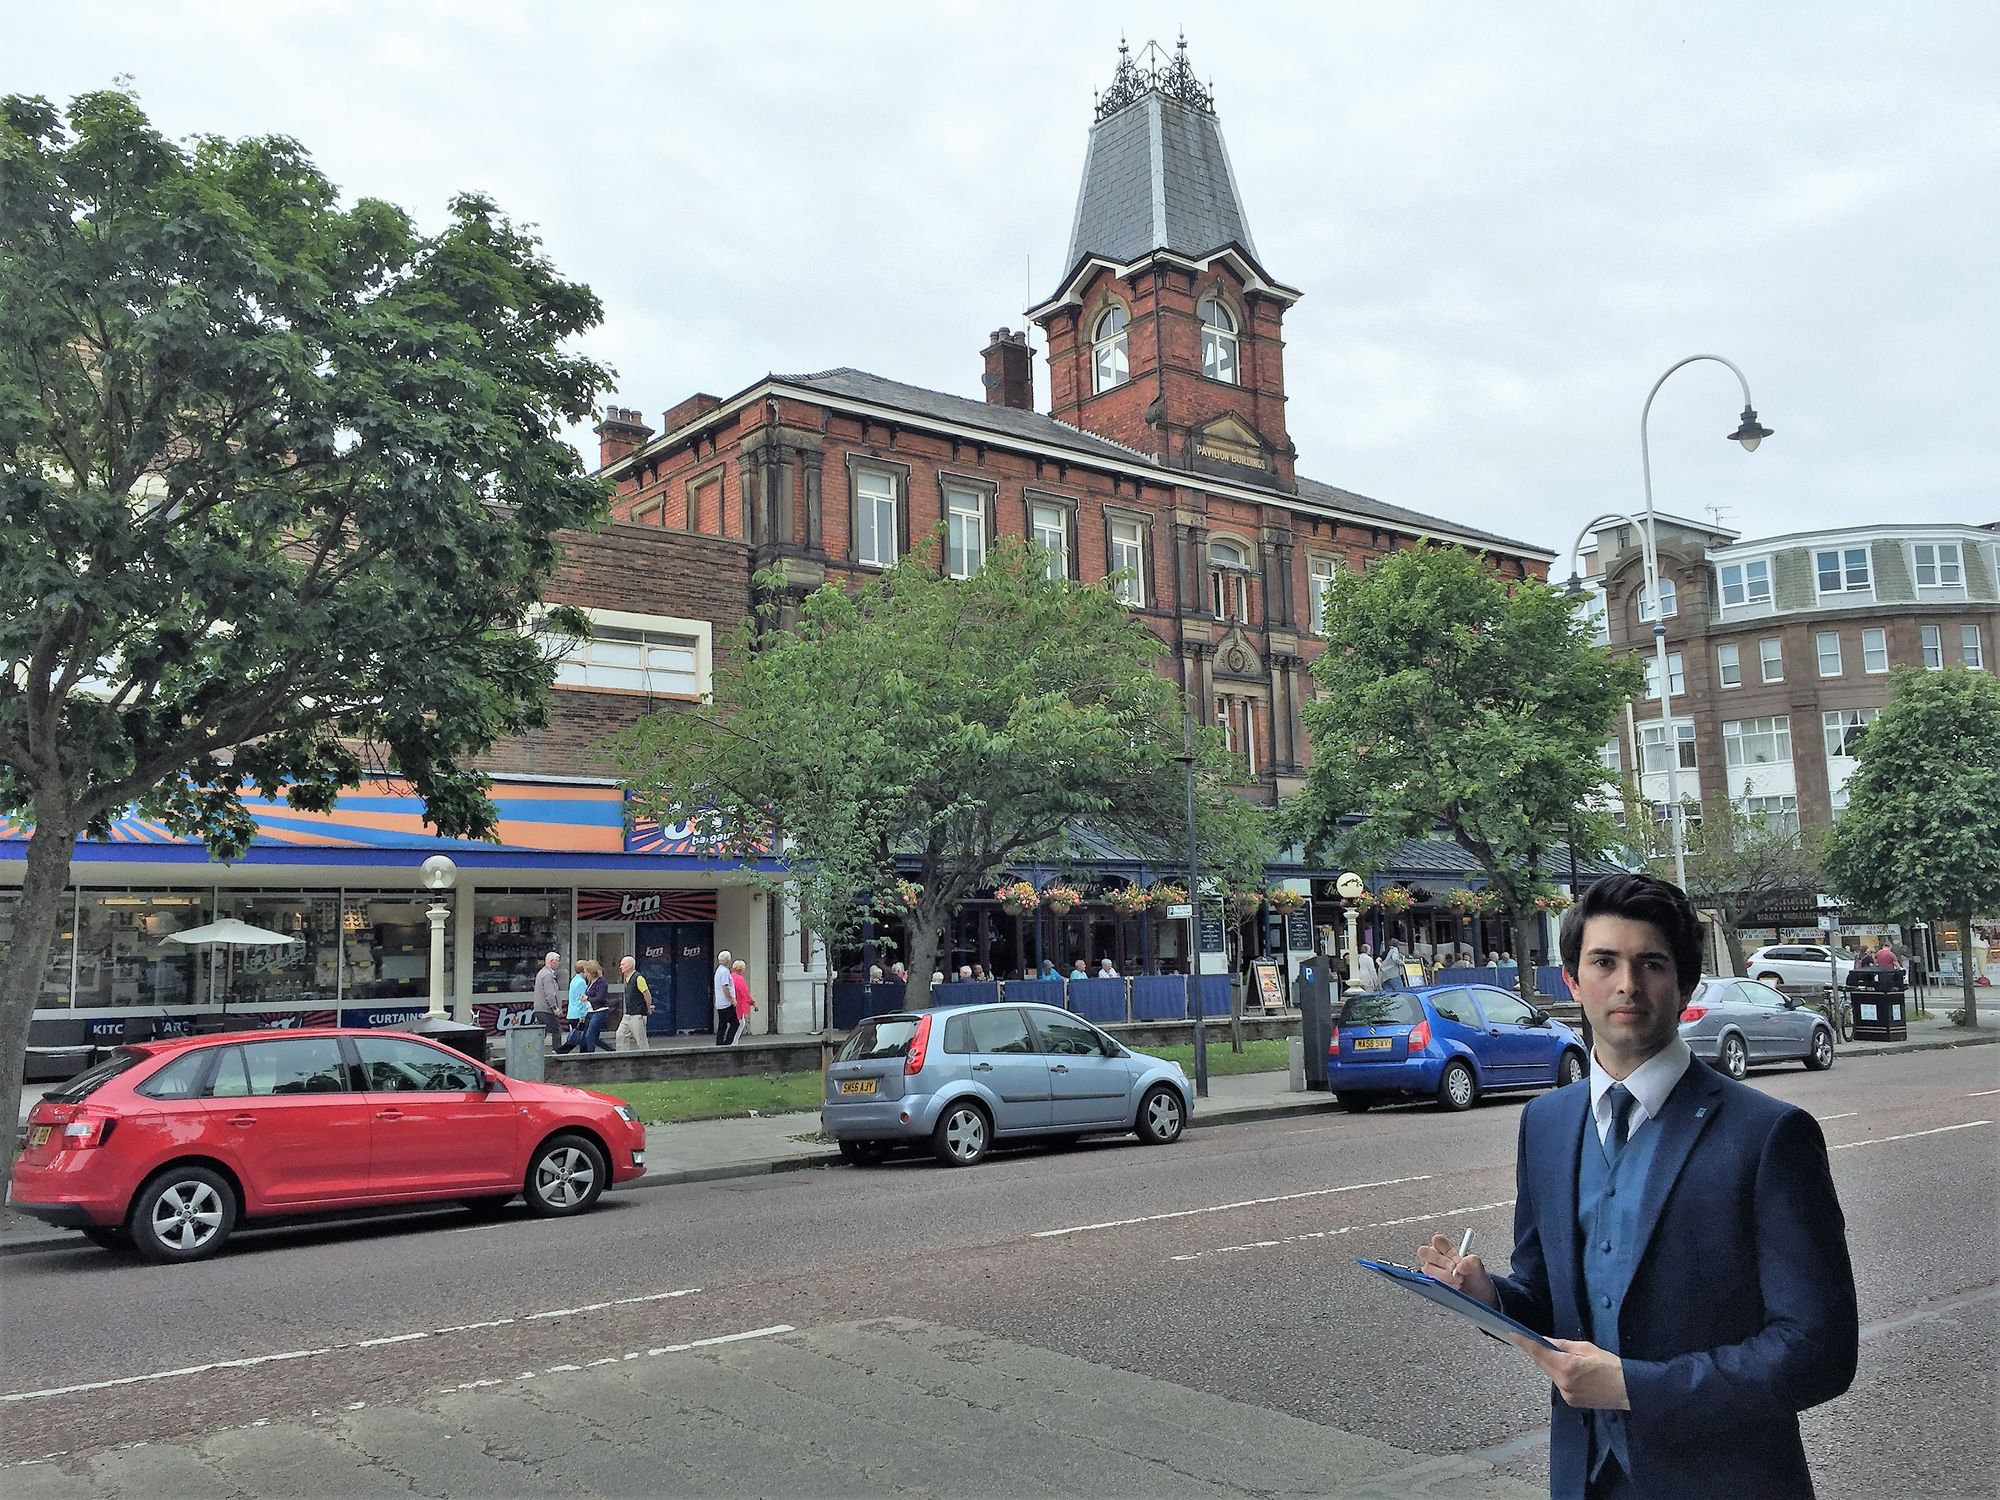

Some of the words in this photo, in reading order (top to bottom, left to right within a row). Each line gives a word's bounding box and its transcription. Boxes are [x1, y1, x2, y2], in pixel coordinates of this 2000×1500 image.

[1196, 443, 1230, 462] PAVILION
[1231, 452, 1266, 470] BUILDINGS
[691, 831, 740, 846] bagain
